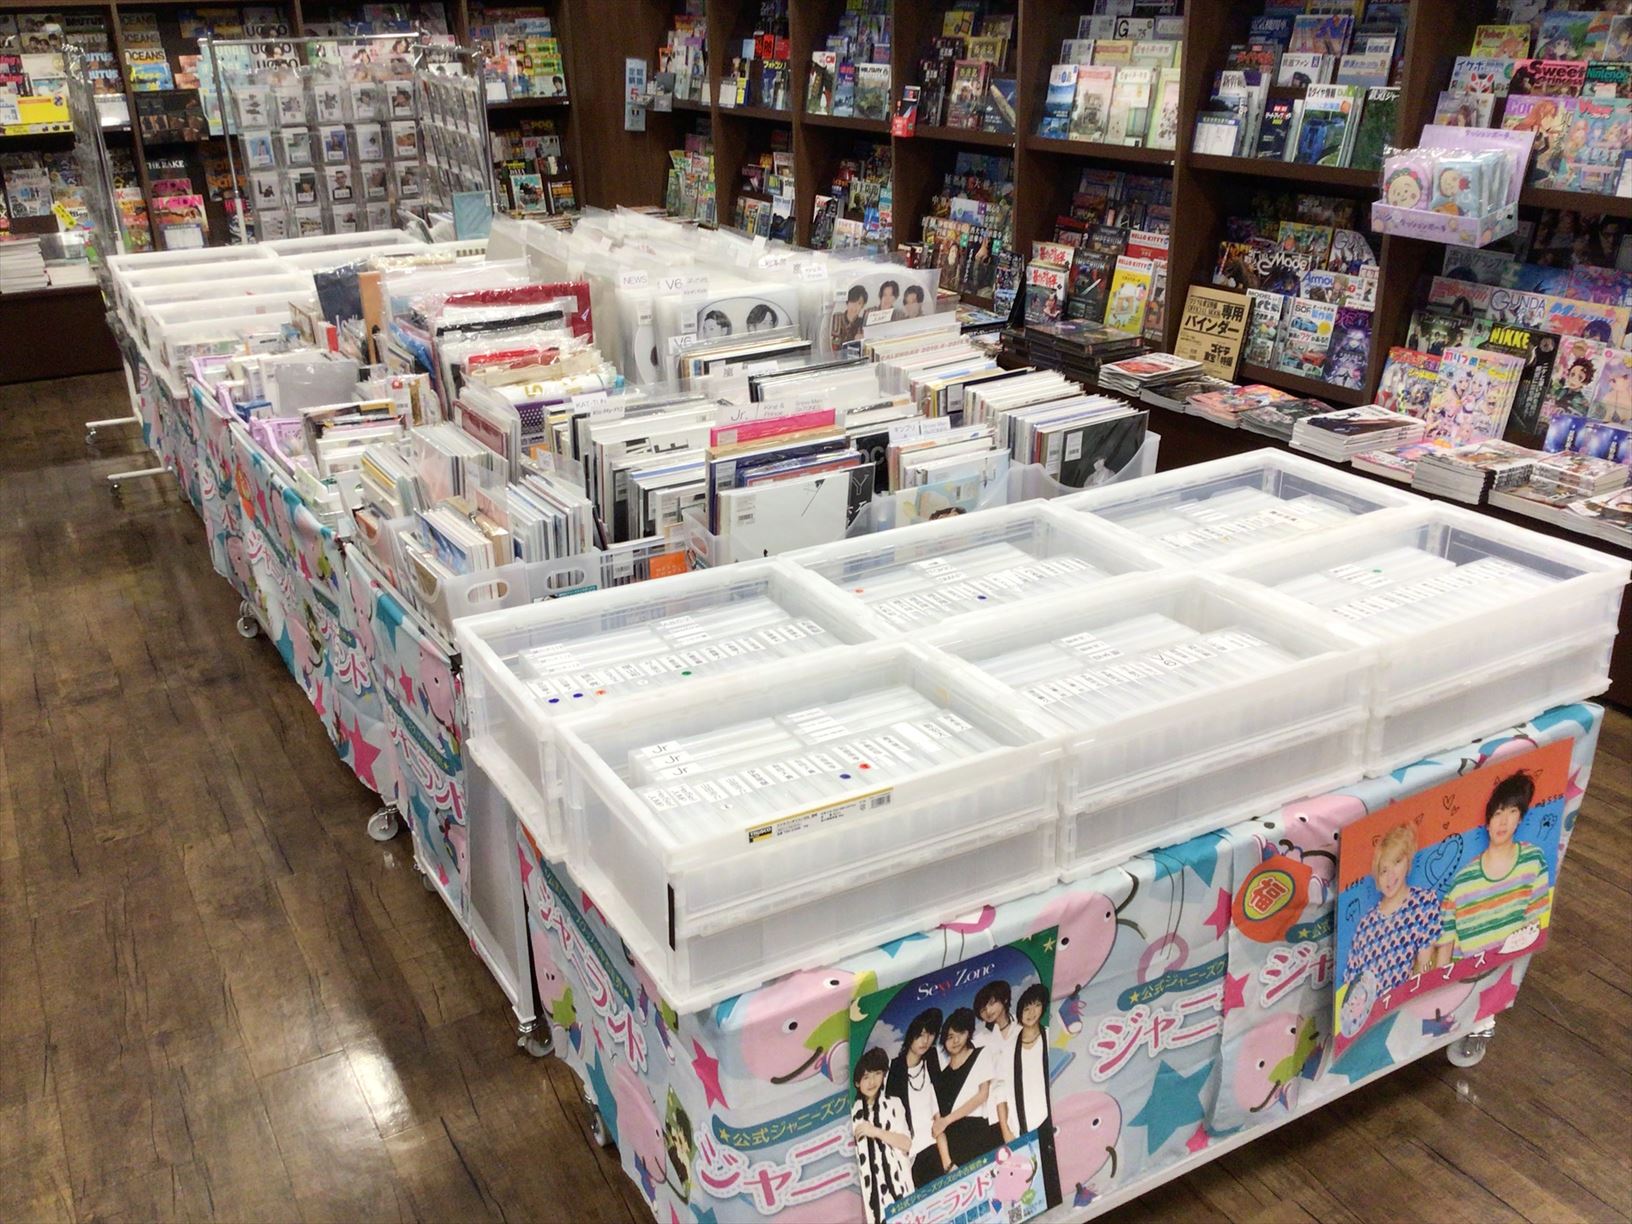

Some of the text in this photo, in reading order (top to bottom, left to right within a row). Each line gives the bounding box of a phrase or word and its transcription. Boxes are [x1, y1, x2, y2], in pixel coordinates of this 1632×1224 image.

[1222, 304, 1245, 323] 専用
[1184, 314, 1240, 335] バインダー
[1489, 325, 1531, 350] NIKKE
[652, 742, 668, 753] Jr
[664, 755, 681, 765] Jr
[672, 767, 689, 777] Jr
[916, 962, 996, 1001] Sexy Zone
[1382, 950, 1488, 1011] テゴマス
